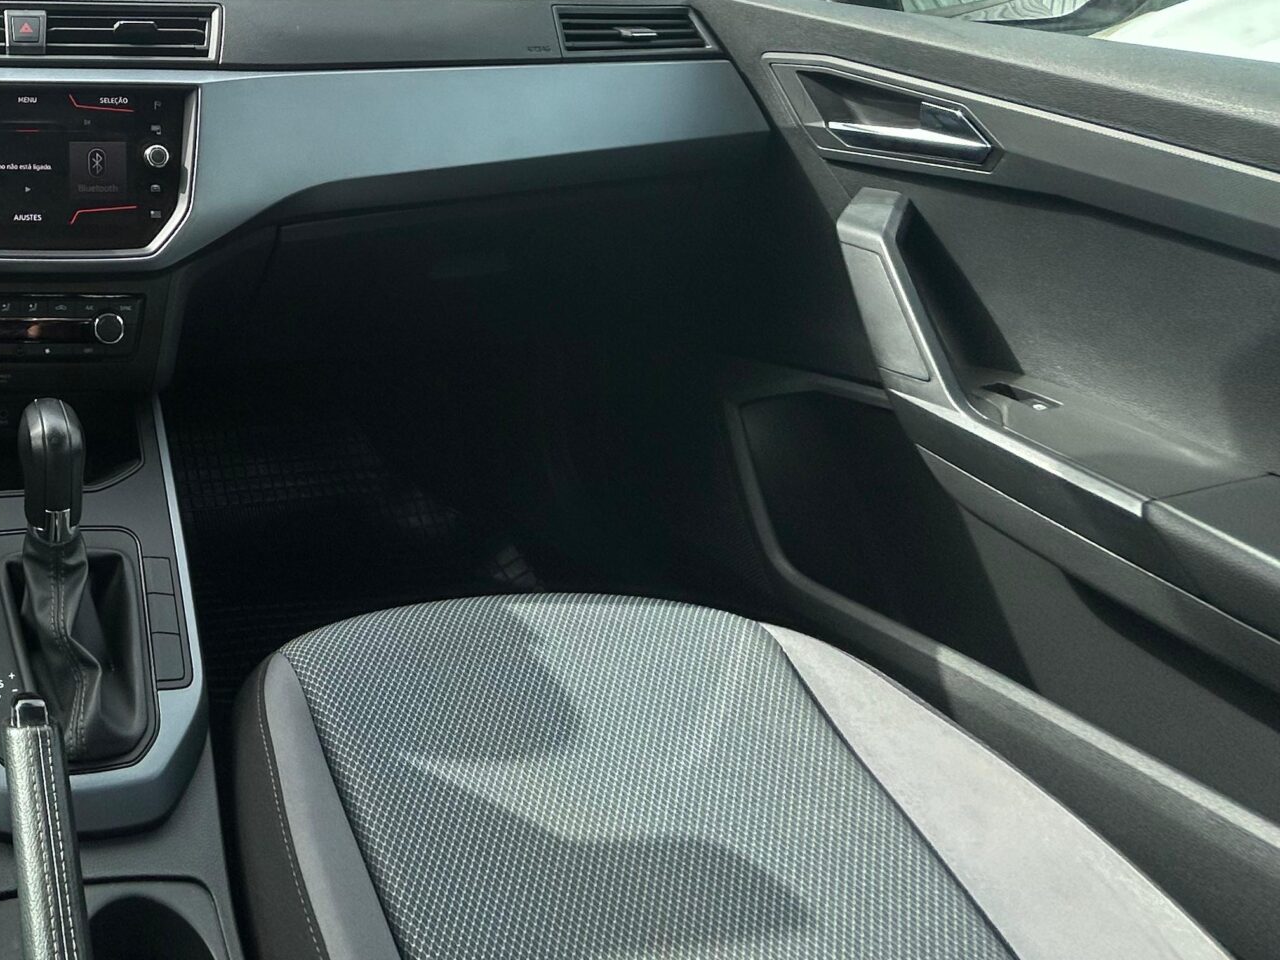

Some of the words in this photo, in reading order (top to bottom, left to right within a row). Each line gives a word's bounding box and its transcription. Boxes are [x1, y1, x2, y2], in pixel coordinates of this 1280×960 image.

[99, 95, 129, 105] SELEÇÃO
[78, 184, 119, 192] Bluetooth
[13, 214, 42, 222] AJUSTES
